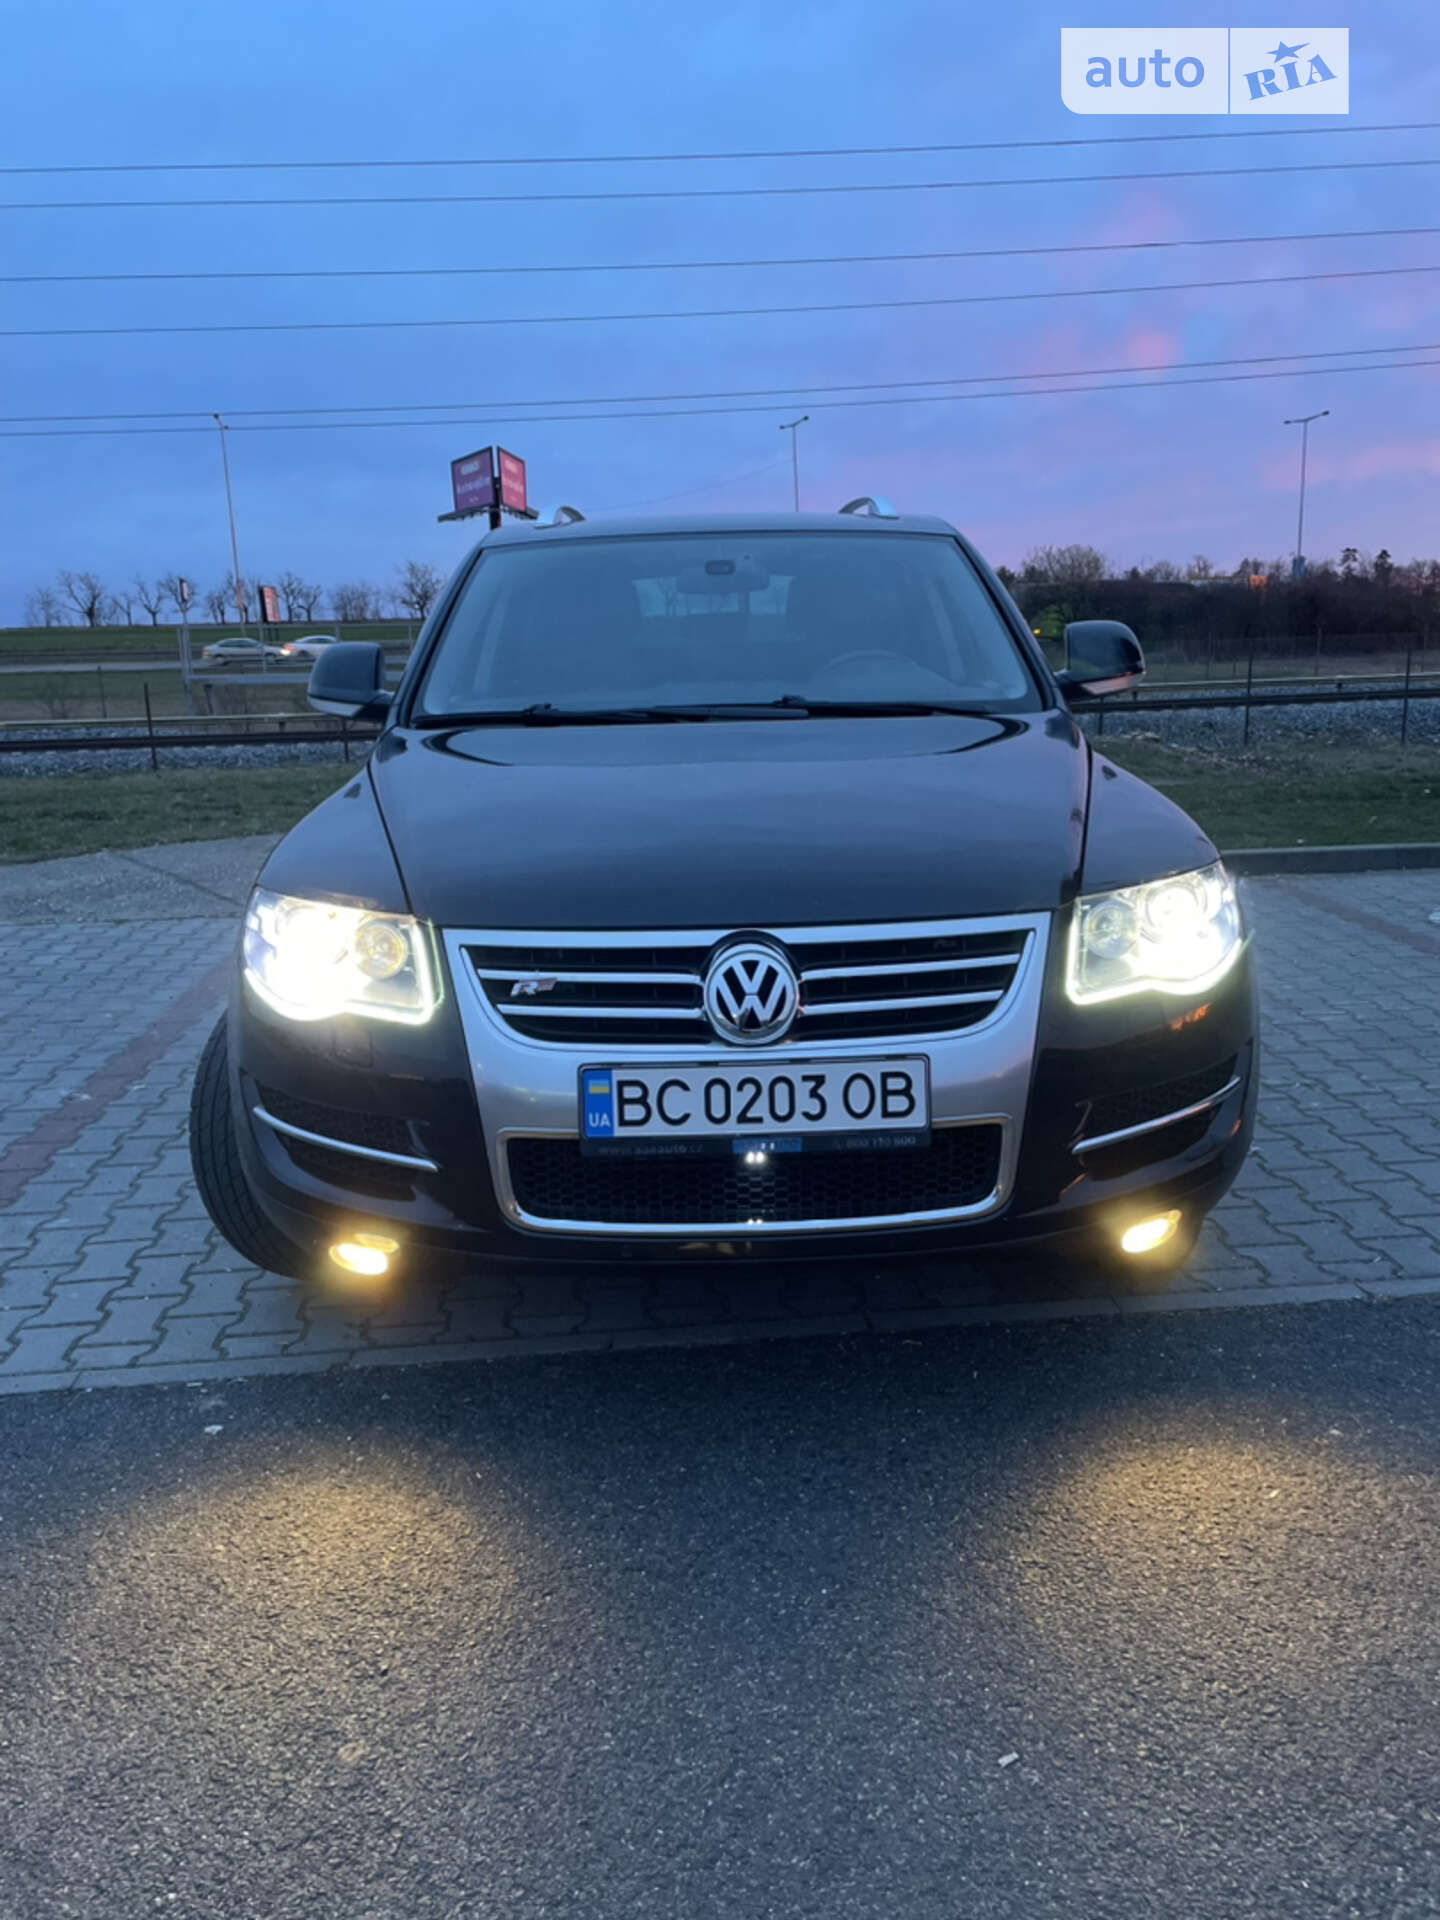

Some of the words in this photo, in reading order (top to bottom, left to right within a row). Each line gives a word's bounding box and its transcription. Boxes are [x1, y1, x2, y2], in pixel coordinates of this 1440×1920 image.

[616, 1078, 691, 1127] BC
[703, 1074, 827, 1125] 0203
[842, 1071, 916, 1119] OB
[588, 1112, 611, 1127] UA
